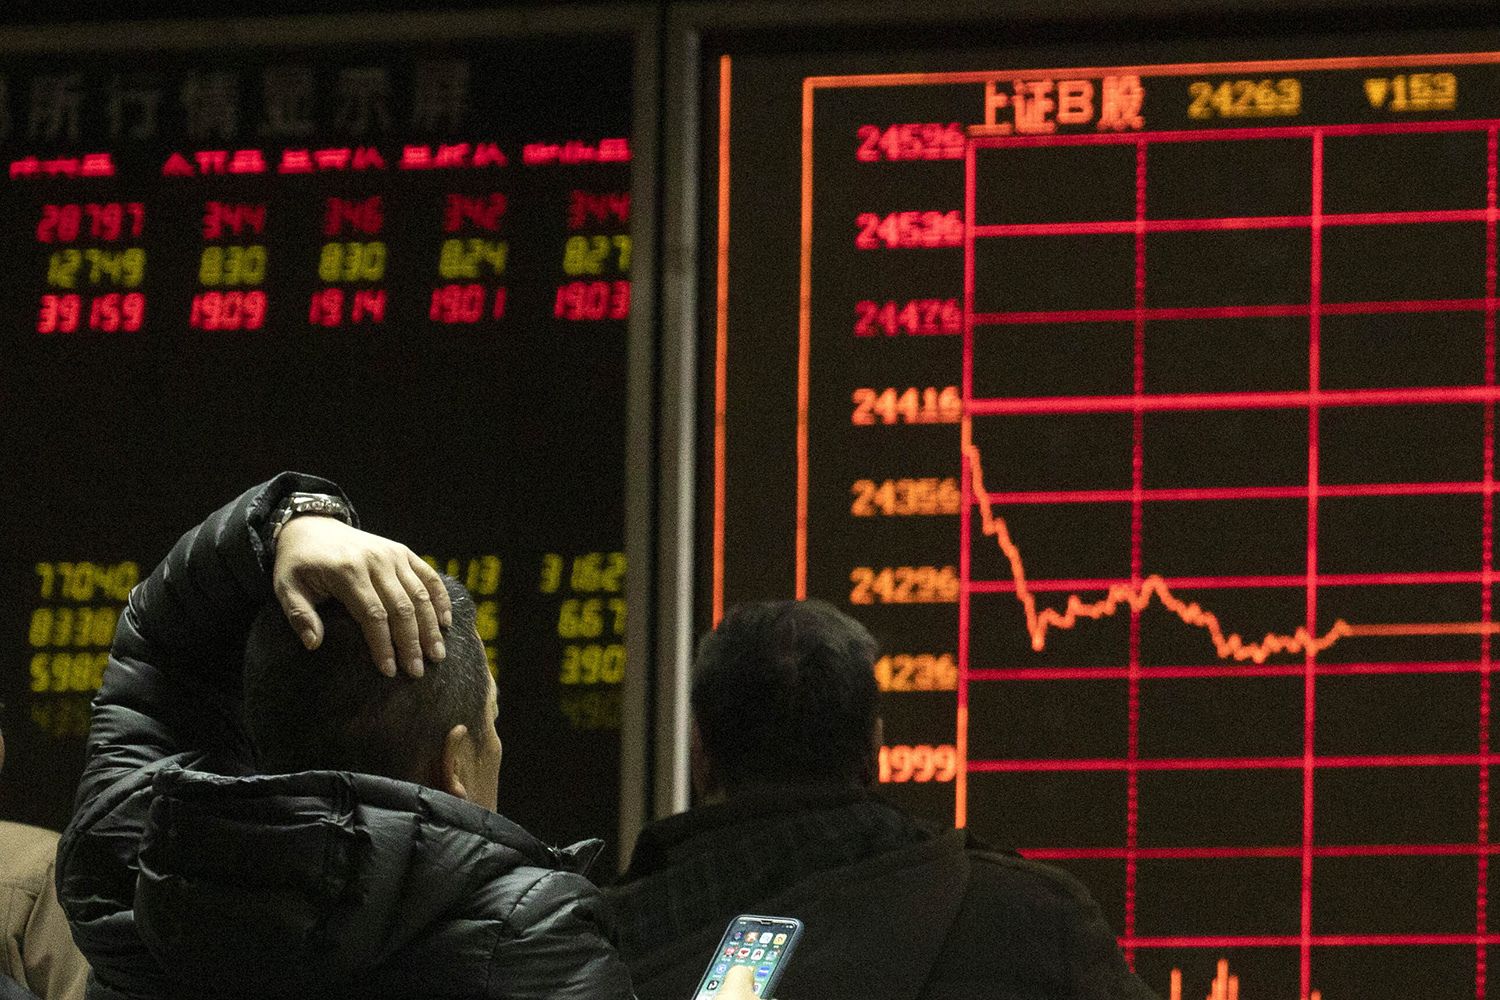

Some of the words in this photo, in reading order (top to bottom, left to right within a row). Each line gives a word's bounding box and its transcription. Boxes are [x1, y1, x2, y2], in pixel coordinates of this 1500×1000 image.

[967, 74, 1147, 137] 上证B股
[188, 290, 268, 332] 1909
[850, 383, 961, 427] 24416
[872, 651, 956, 693] 4236
